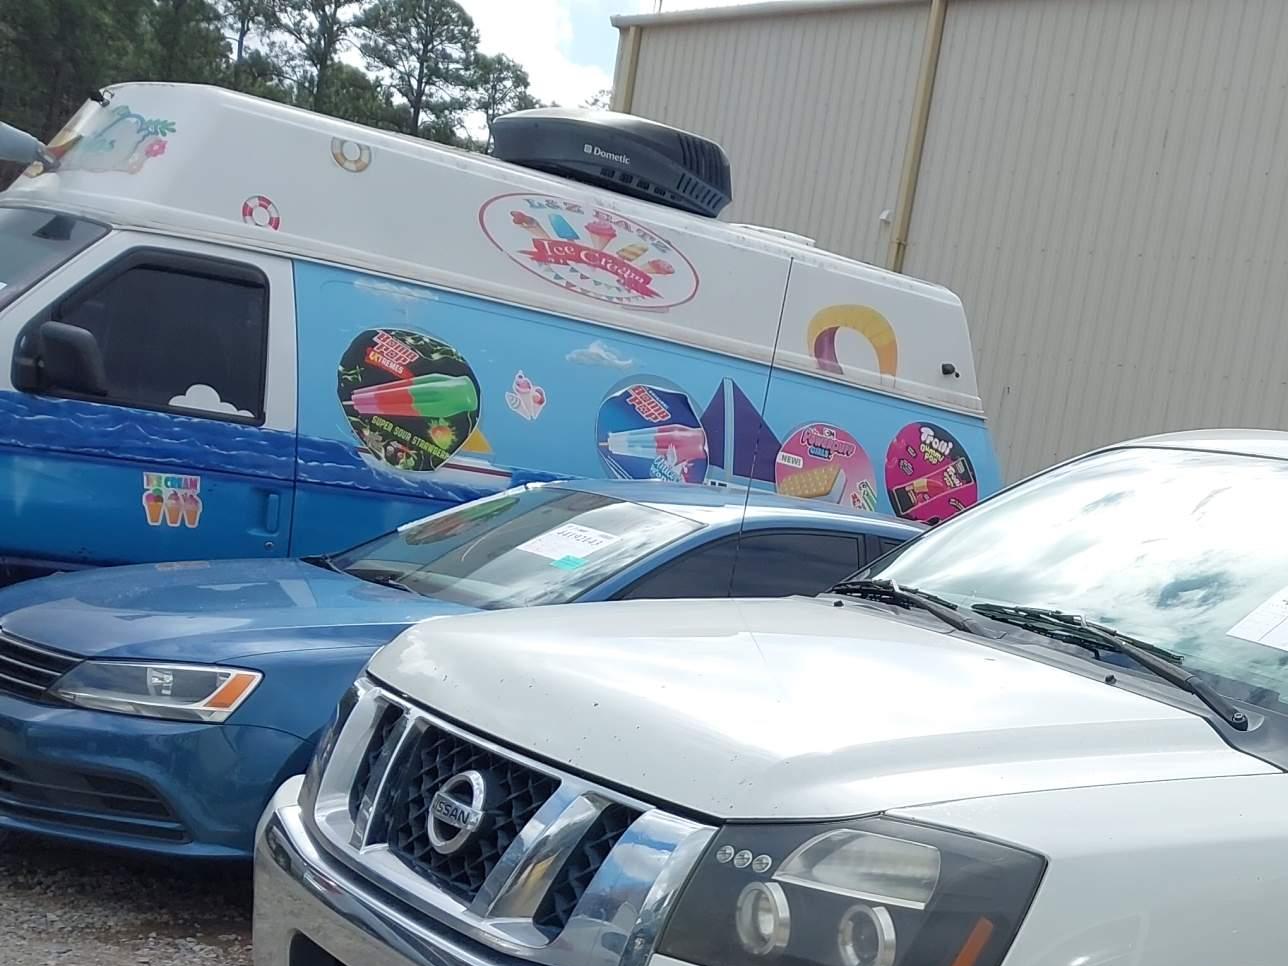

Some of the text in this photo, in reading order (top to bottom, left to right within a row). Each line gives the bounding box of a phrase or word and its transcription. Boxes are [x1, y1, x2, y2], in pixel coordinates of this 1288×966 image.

[593, 146, 631, 165] Dometic
[543, 240, 646, 286] Ice Cream
[371, 415, 394, 433] SUPER
[394, 427, 412, 441] SOUR
[781, 454, 802, 467] NEW!
